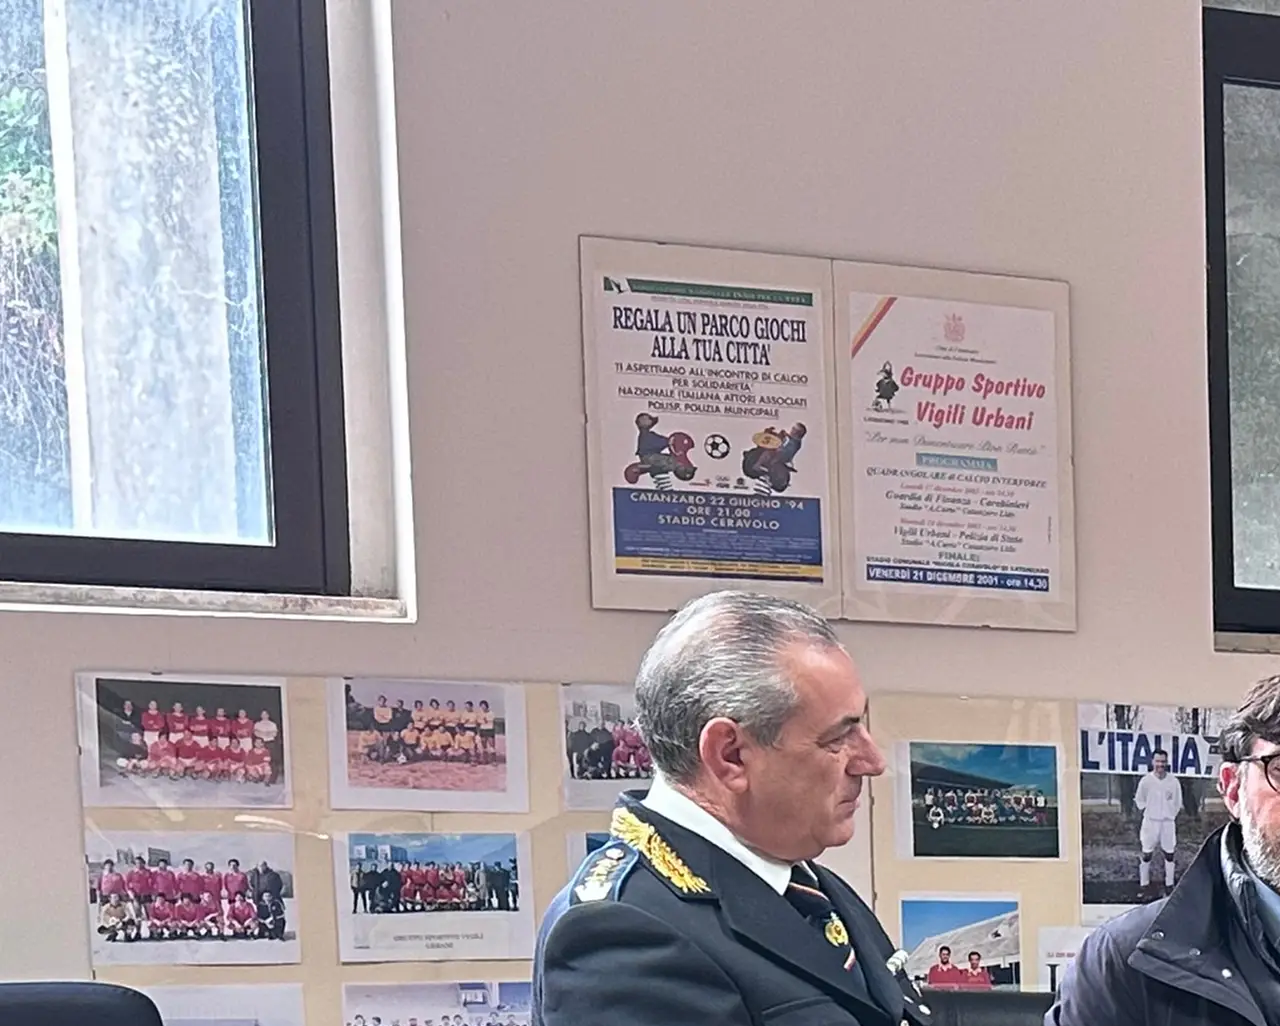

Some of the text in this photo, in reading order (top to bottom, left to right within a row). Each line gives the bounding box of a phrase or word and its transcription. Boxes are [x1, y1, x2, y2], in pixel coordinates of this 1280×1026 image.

[613, 306, 807, 342] REGALA UN PARCO GIOCHI
[651, 335, 771, 366] ALLA TUA CITTA'
[615, 362, 808, 384] TI ASPETTIAMO ALL'INCONTRO DI CALCIO
[672, 378, 689, 388] PER
[900, 366, 1046, 400] Gruppo Sportivo
[618, 386, 807, 408] NAZIONALE ITALIANA ATTORI ASSOCIATI
[684, 403, 721, 414] POLIZIA
[724, 405, 779, 418] MUNICIPALE
[917, 401, 1034, 430] Vigili Urbani
[922, 456, 992, 470] PROGRAMMA
[866, 466, 946, 480] QUADRANGOLARE
[957, 474, 989, 484] CALCIO
[992, 476, 1047, 488] INTERFORZE
[630, 492, 804, 510] CATANZARO 22 GIUGNO '94
[885, 490, 921, 501] Guardia
[924, 493, 932, 502] di
[935, 494, 971, 505] Finanza
[980, 498, 1029, 509] Carabinieri
[687, 506, 751, 517] ORE 21.00
[658, 514, 780, 530] STADIO CERAVOLO
[990, 533, 998, 542] di
[913, 570, 923, 580] 21
[926, 571, 975, 584] DICEMBRE
[977, 574, 999, 585] 2001
[1006, 579, 1021, 587] ore
